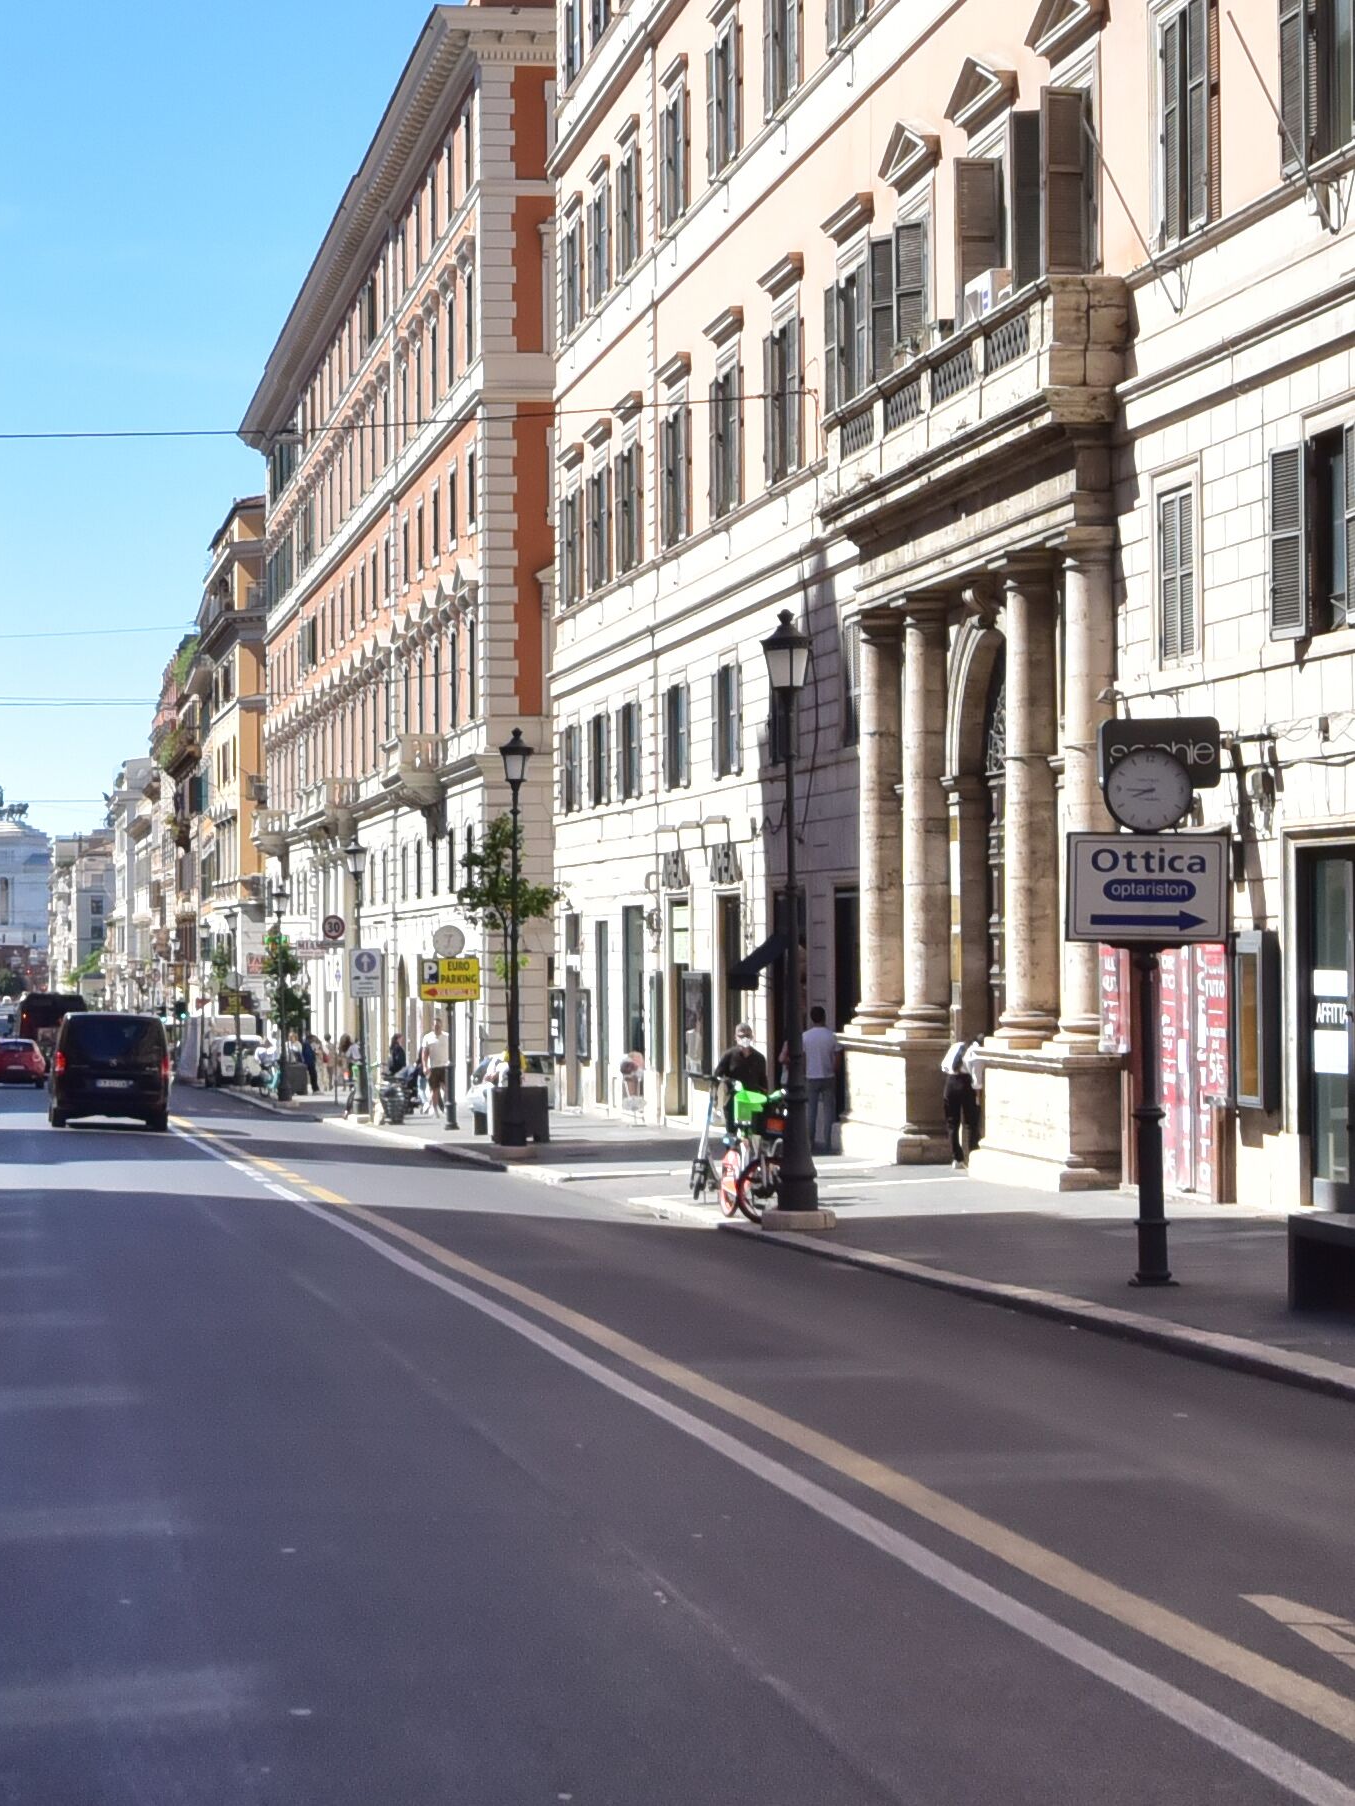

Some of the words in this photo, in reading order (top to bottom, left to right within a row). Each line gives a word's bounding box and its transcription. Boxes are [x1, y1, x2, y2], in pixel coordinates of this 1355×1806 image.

[1091, 848, 1206, 874] Ottica
[1111, 881, 1188, 898] optariston
[327, 921, 341, 933] 30
[447, 961, 470, 971] EURO
[441, 974, 477, 985] PARKING
